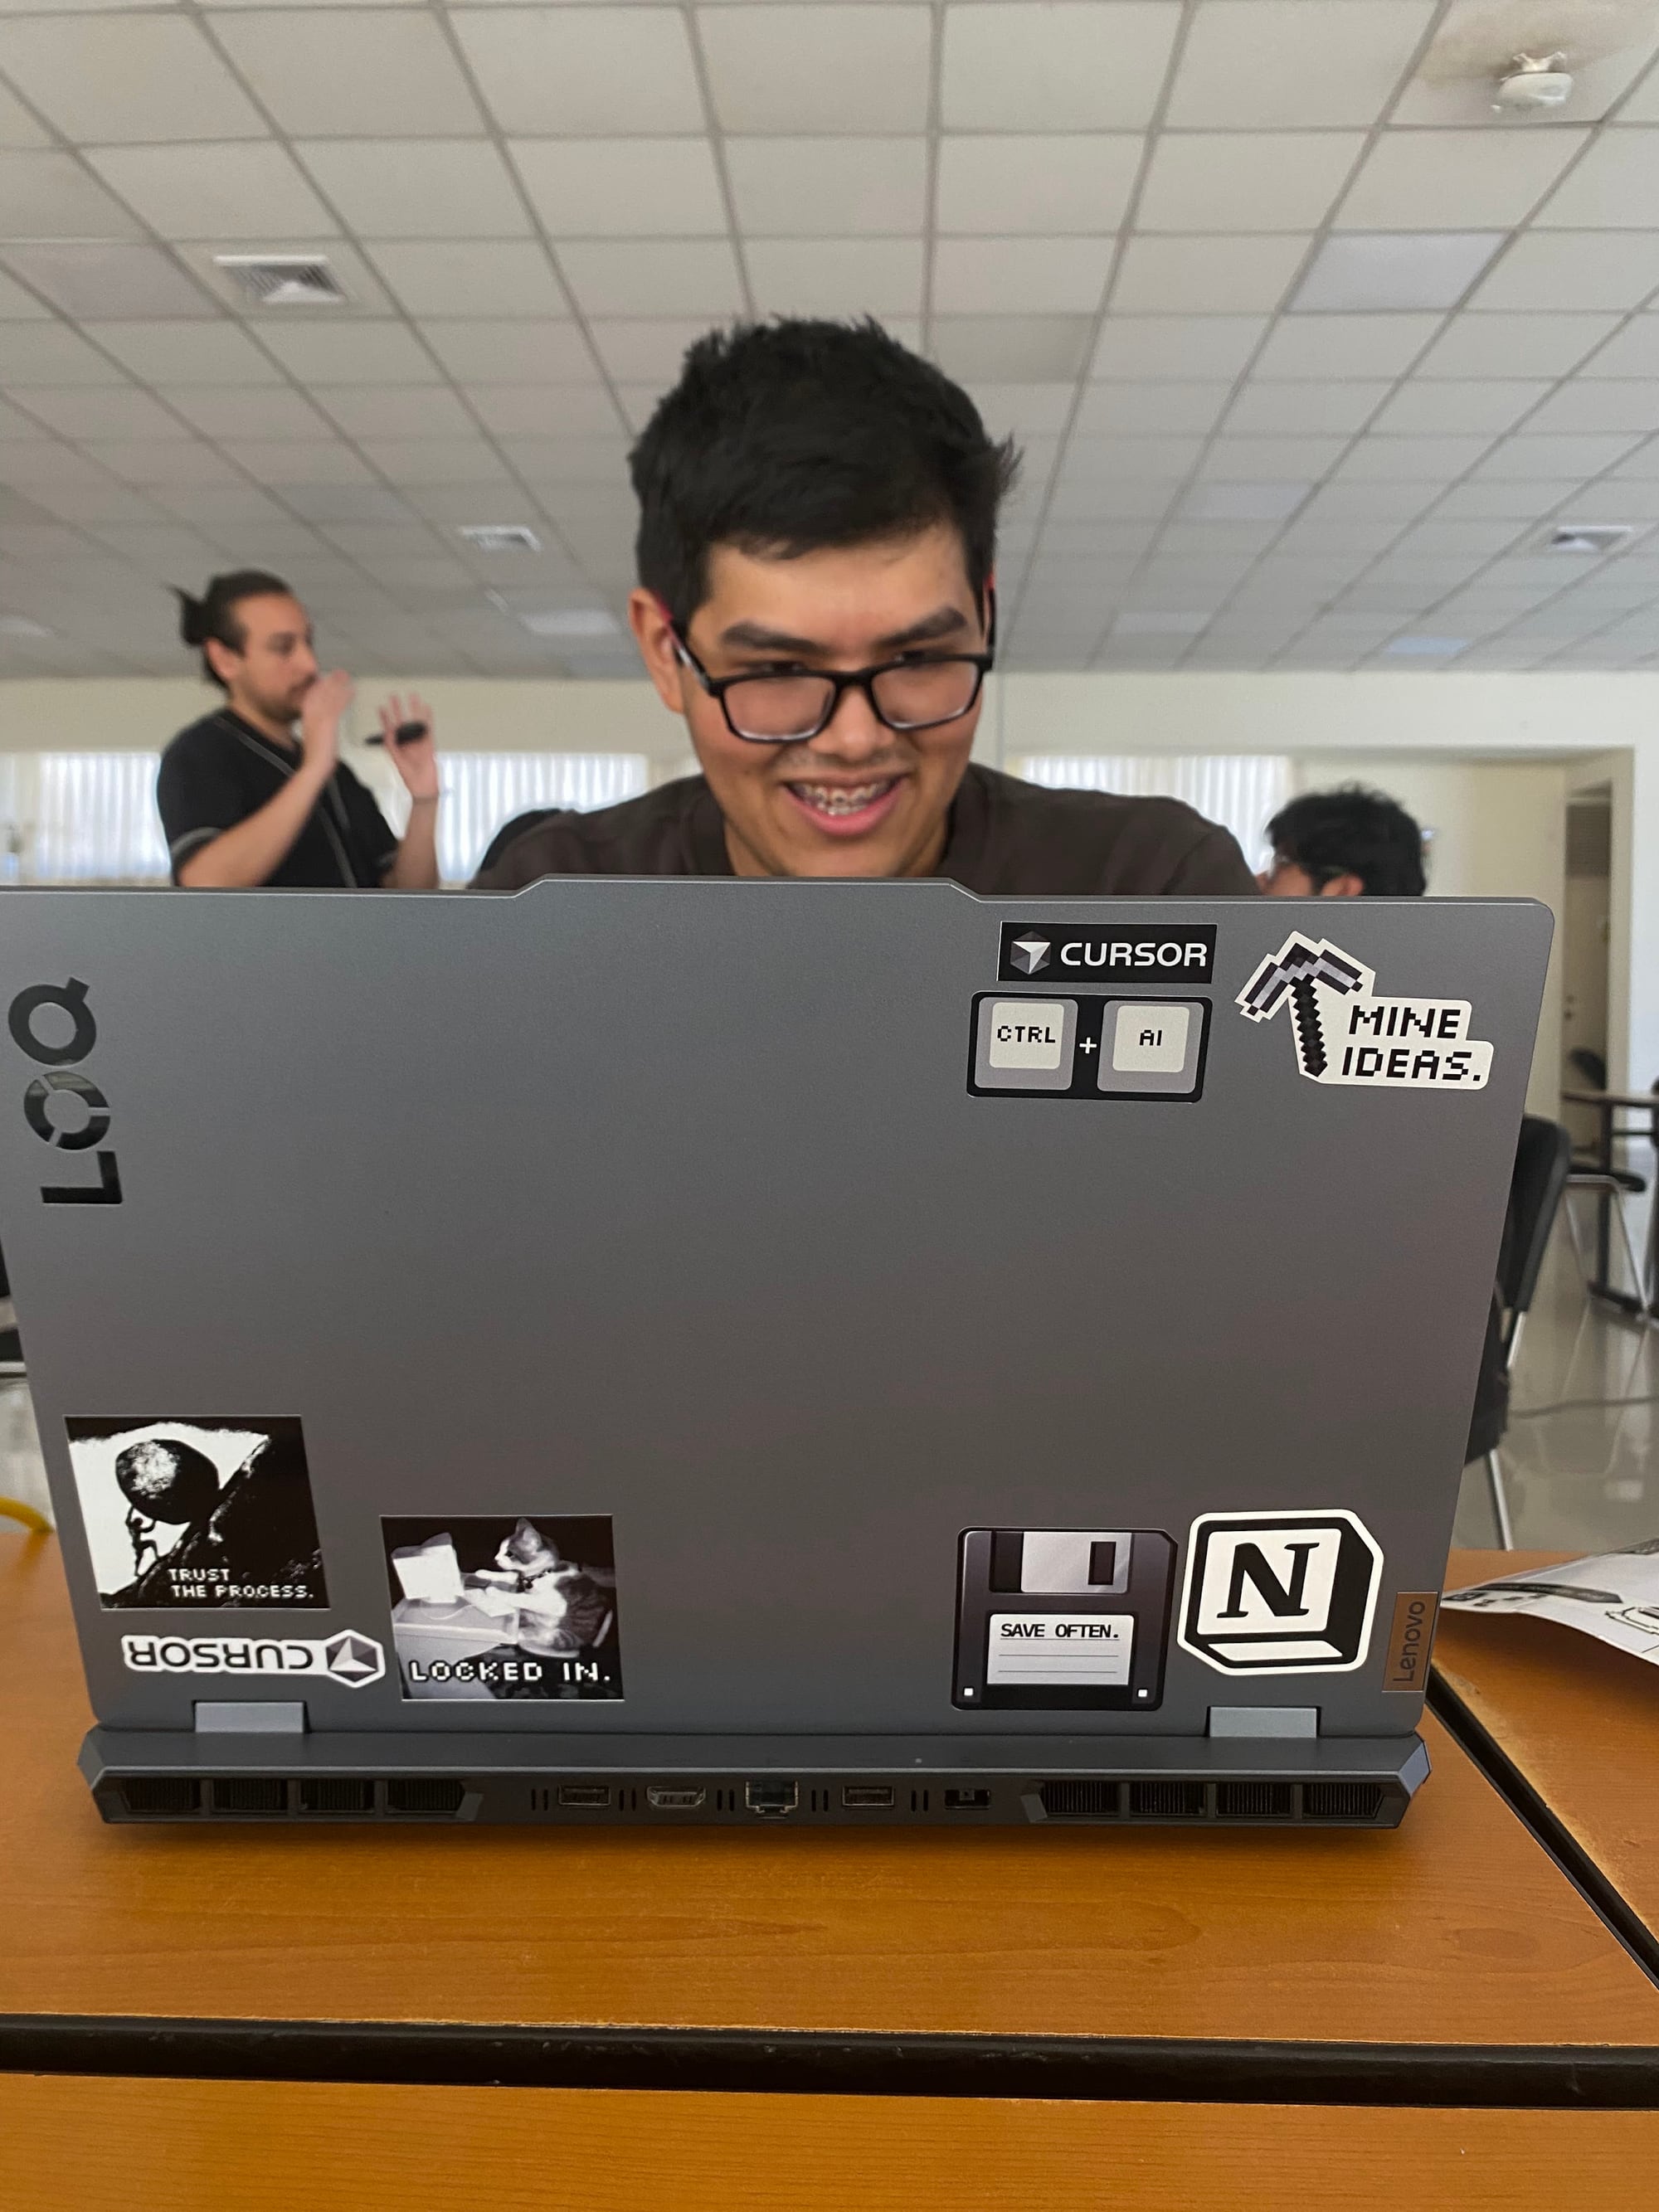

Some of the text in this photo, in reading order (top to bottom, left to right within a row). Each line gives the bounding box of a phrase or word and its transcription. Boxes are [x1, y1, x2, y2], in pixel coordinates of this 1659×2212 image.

[1060, 942, 1208, 967] CURSOR
[1349, 1005, 1461, 1039] MINE
[997, 1025, 1162, 1054] CTRL + AI
[1341, 1047, 1481, 1082] IDEAS.
[8, 976, 123, 1204] LOQ
[169, 1568, 231, 1582] TRUST
[1215, 1542, 1321, 1619] N
[171, 1584, 314, 1599] THE PROCESS.
[1000, 1623, 1121, 1640] SAVE OFTEN.
[1394, 1601, 1425, 1682] Lenovo
[129, 1641, 312, 1670] CURSOR
[409, 1660, 611, 1682] LOCKED IN.
